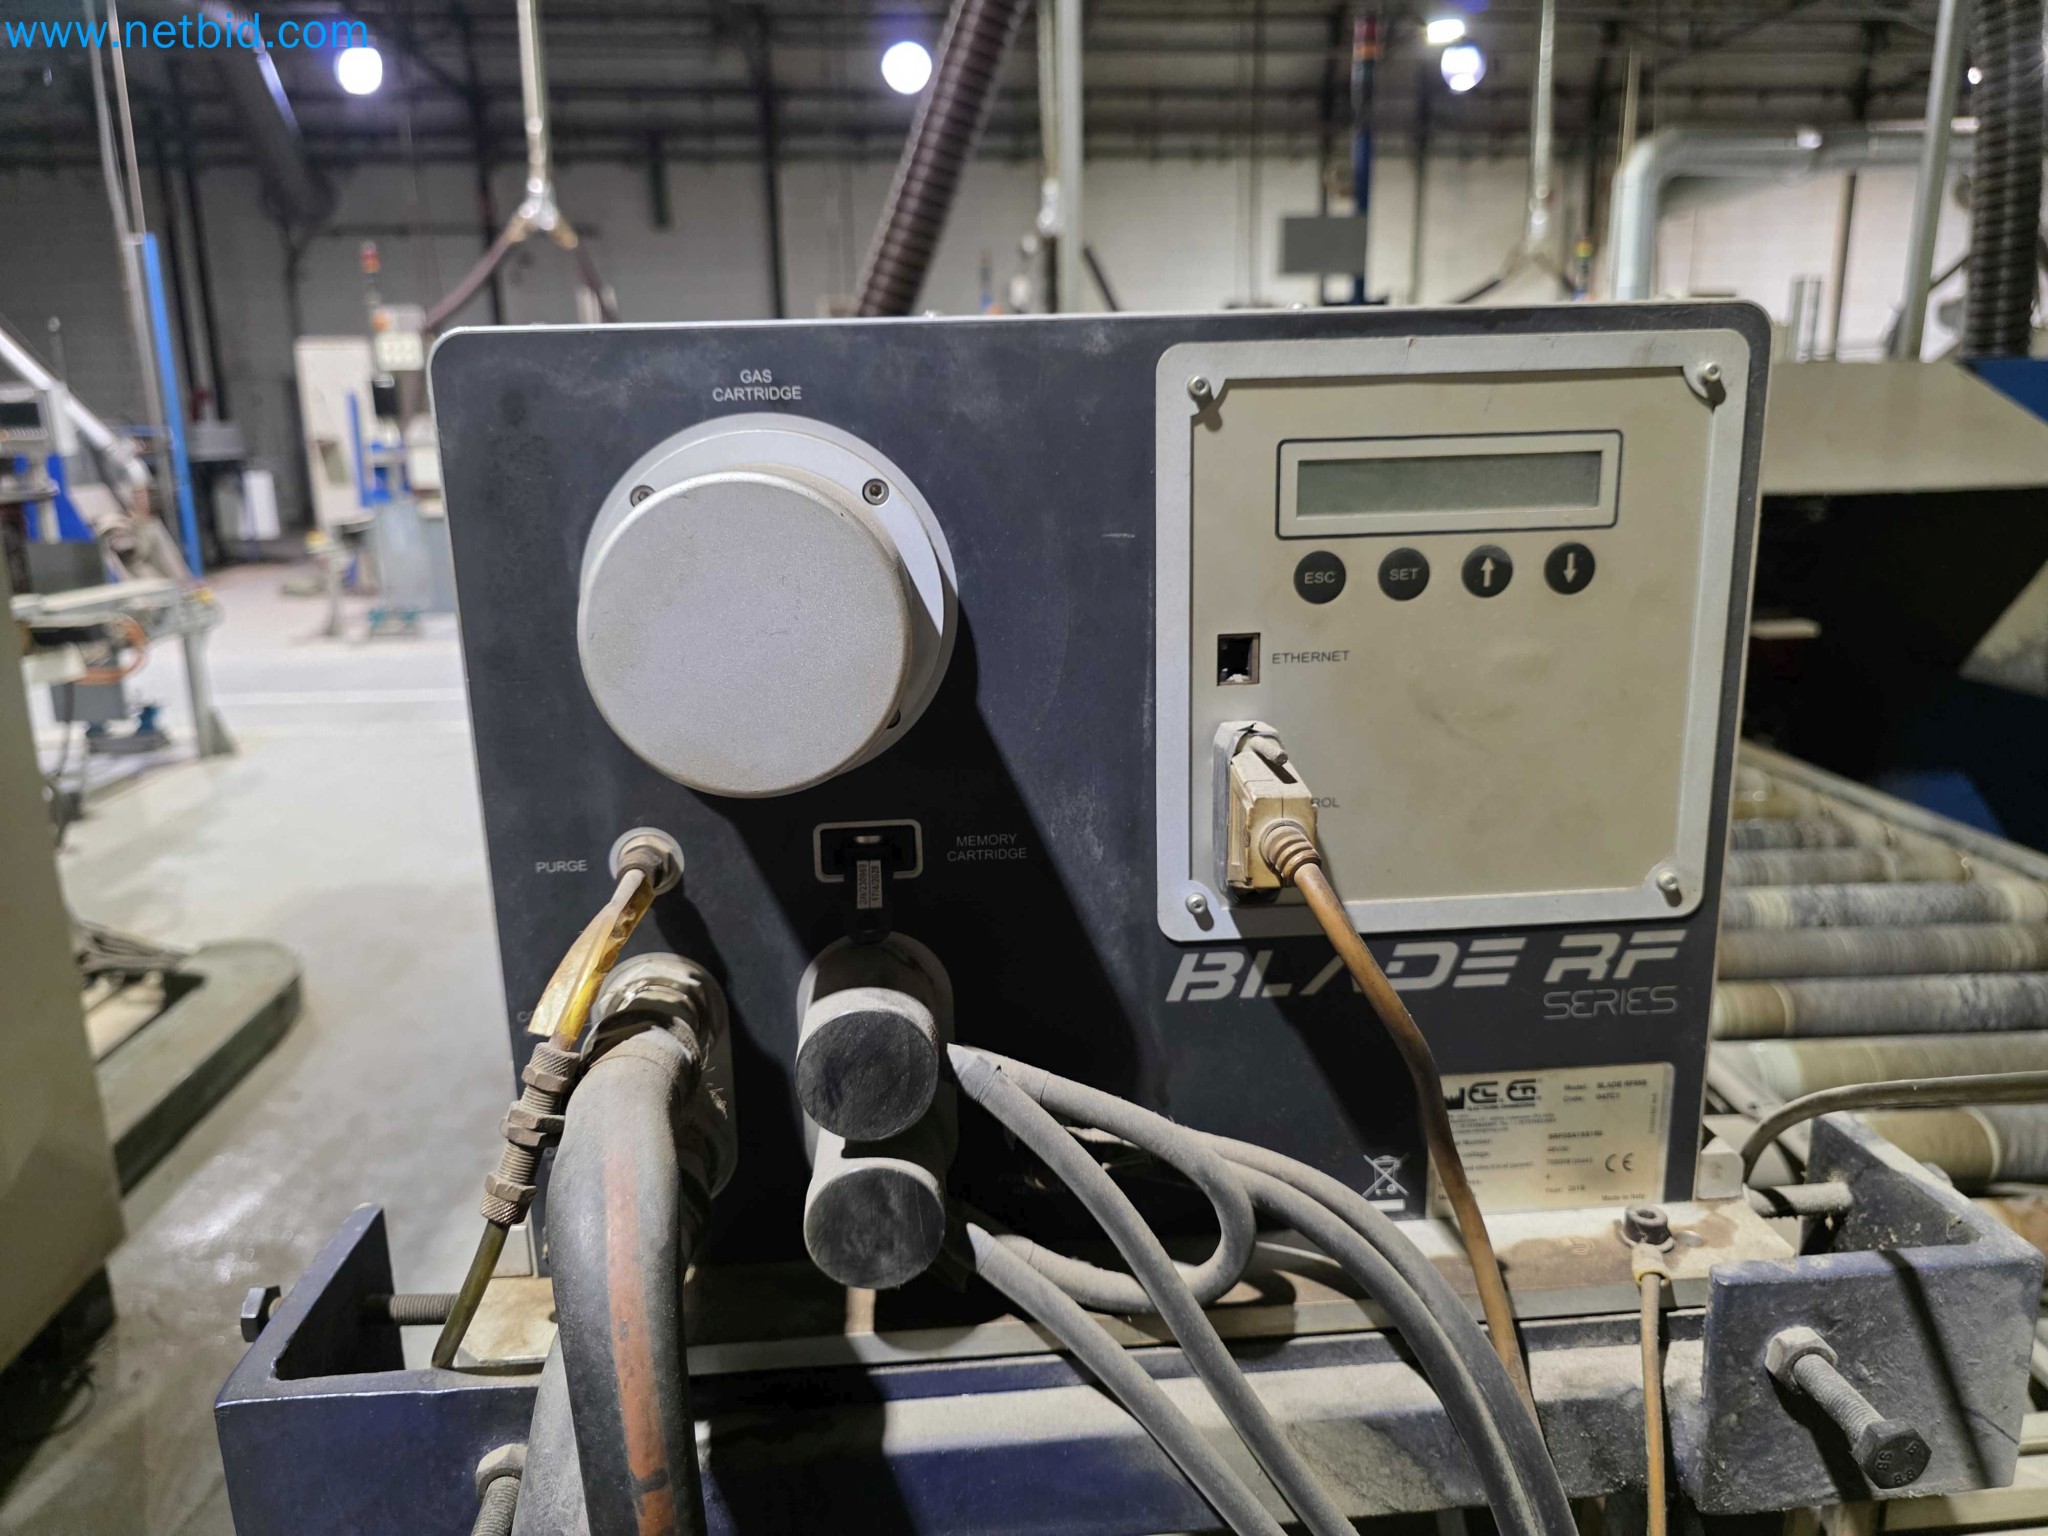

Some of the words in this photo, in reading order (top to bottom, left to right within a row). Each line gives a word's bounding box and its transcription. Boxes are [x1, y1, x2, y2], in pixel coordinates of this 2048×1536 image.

[740, 369, 772, 383] GAS
[712, 386, 802, 402] CARTRIDGE
[1304, 571, 1336, 584] ESC
[1389, 568, 1419, 581] SET
[1272, 650, 1349, 664] ETHERNET
[956, 833, 1018, 847] MEMORY
[947, 847, 1027, 862] CARTRIDGE
[536, 860, 588, 873] PURGE
[1543, 929, 1687, 983] RF
[1543, 985, 1678, 1020] SERIES
